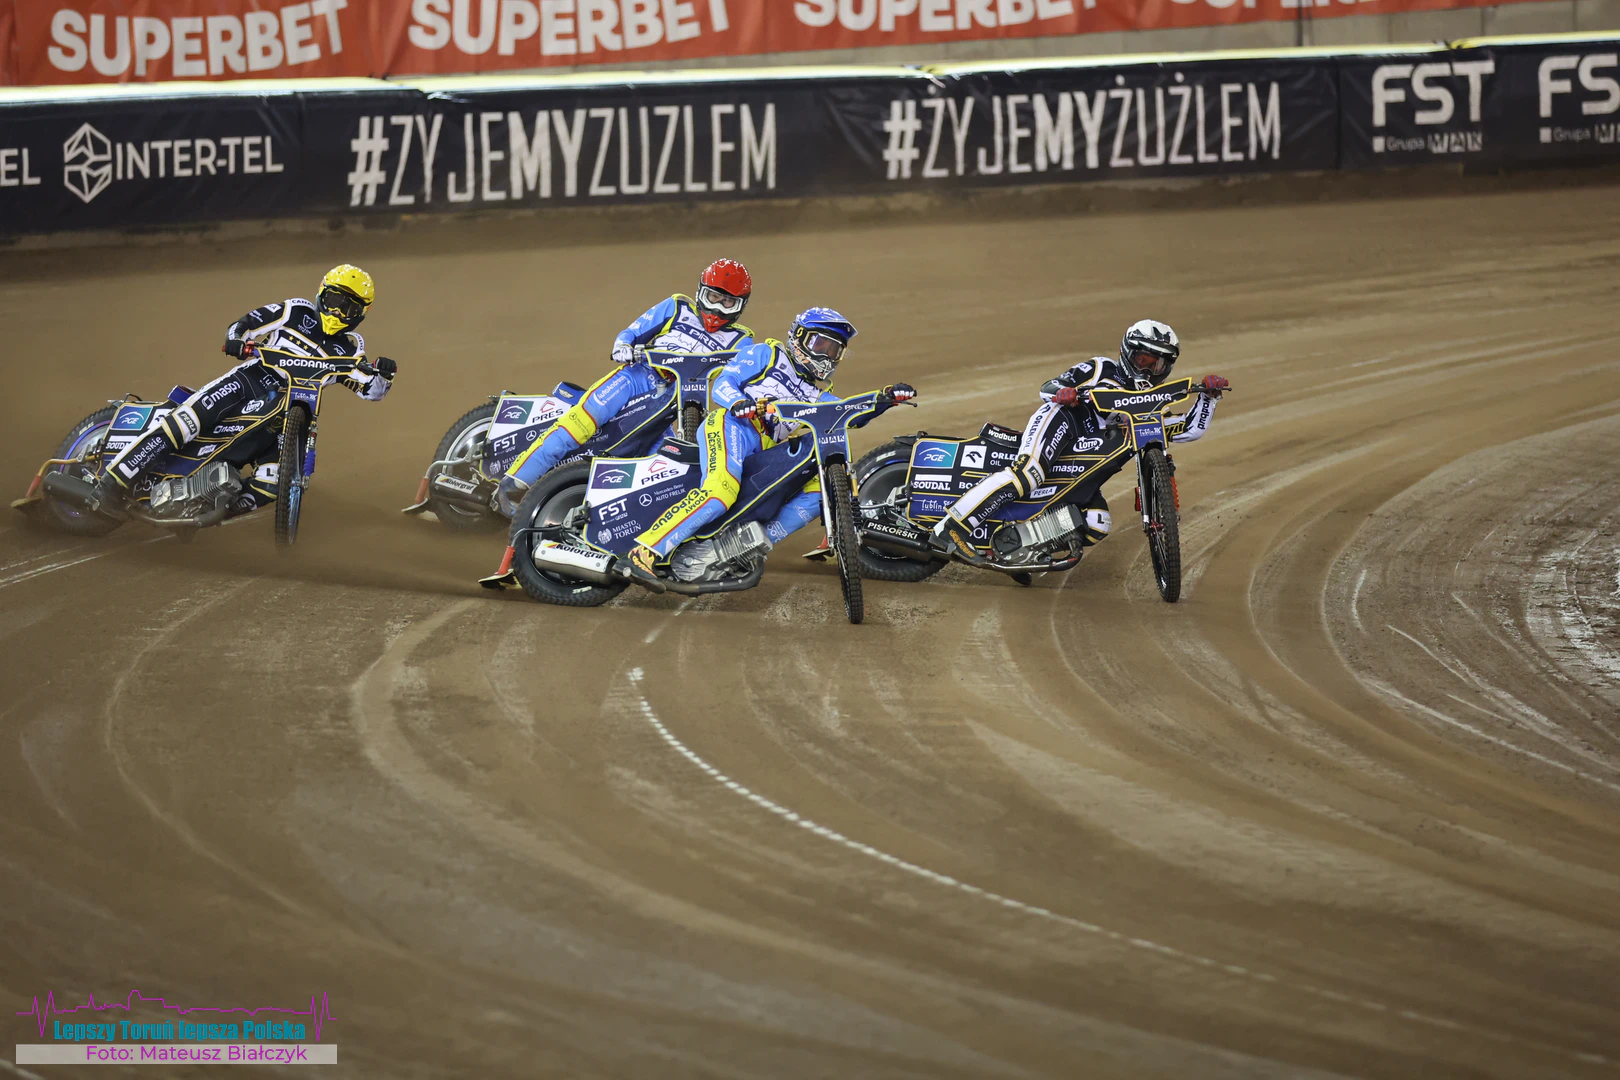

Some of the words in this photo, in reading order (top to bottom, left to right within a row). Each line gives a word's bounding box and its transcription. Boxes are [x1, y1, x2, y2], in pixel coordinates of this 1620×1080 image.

[48, 0, 348, 76] SUPERBET
[1371, 60, 1495, 127] FST
[1386, 136, 1425, 152] Grupa
[116, 136, 284, 180] INTER-TEL
[279, 358, 337, 372] BOGDANKA
[661, 356, 685, 365] LAVOR
[1113, 393, 1172, 408] BOGDANKA
[504, 411, 522, 419] PGE
[532, 408, 564, 424] PRES
[793, 407, 818, 418] LAVOR
[121, 417, 140, 425] PGE
[493, 433, 518, 452] FST
[1050, 421, 1069, 450] maspo
[106, 441, 132, 450] SOUD
[1078, 440, 1098, 450] LOTTO
[923, 454, 946, 462] PGE
[1052, 465, 1085, 473] maspo
[601, 475, 625, 484] PGE
[640, 468, 680, 485] PRES
[912, 481, 951, 491] SOUDAL
[655, 493, 669, 502] AUTO
[668, 488, 686, 499] FRELIK
[598, 497, 628, 521] FST
[651, 490, 701, 532] EXPOBUD
[612, 519, 637, 533] MIASTO
[614, 523, 642, 540] TORUŃ
[867, 521, 919, 540] PISKORSKI
